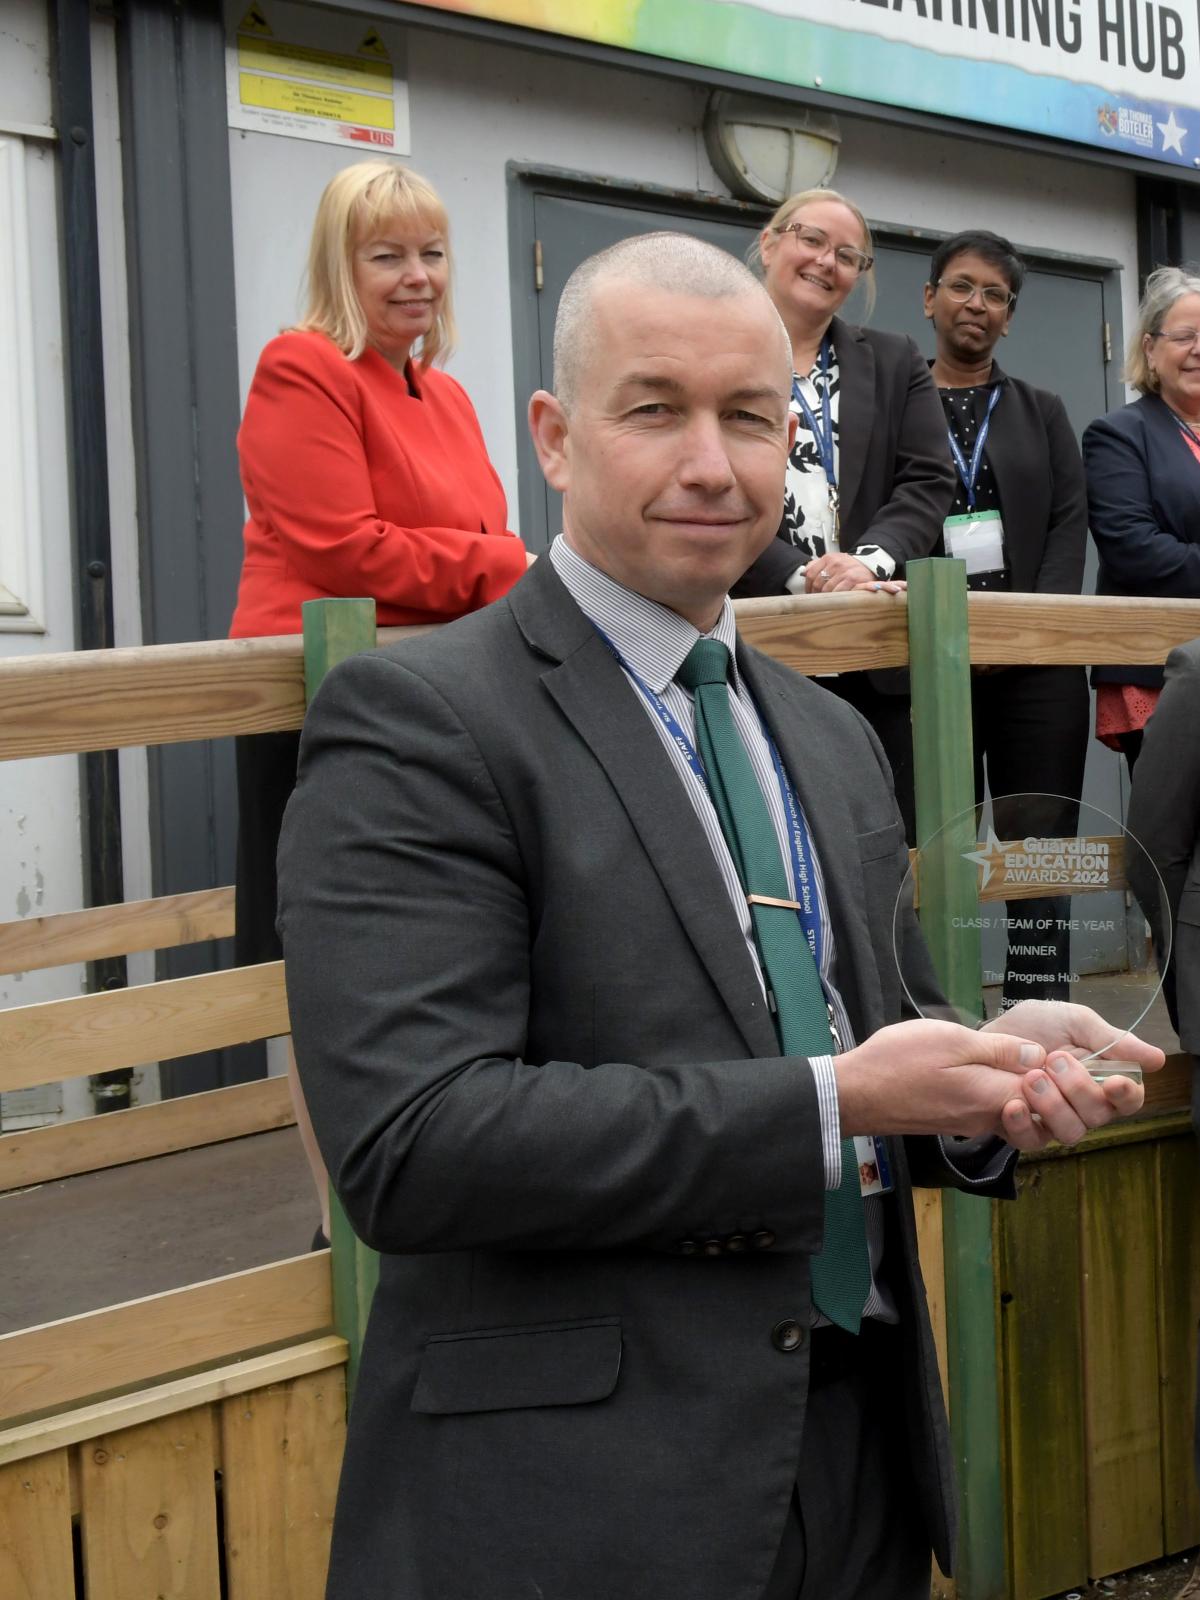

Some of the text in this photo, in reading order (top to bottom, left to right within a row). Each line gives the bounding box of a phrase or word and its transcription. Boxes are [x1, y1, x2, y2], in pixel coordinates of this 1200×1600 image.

[1099, 0, 1186, 80] HUB
[1119, 119, 1153, 141] BOTELER
[368, 131, 394, 147] UIS
[662, 711, 671, 723] Sir
[675, 736, 693, 761] STAFF
[787, 792, 798, 819] Church
[793, 820, 801, 829] of
[794, 830, 804, 862] England
[1023, 837, 1109, 855] Guardian
[1004, 853, 1109, 870] EDUCATION
[799, 864, 809, 884] High
[1004, 870, 1109, 884] AWARDS 2024
[802, 886, 813, 914] School
[951, 917, 990, 929] CLASS
[1000, 918, 1033, 930] TEAM
[1036, 920, 1052, 930] OF
[1056, 919, 1079, 930] THE
[1083, 920, 1115, 931] YEAR
[1008, 945, 1057, 956] WINNER
[984, 971, 1080, 984] The Progress Hub
